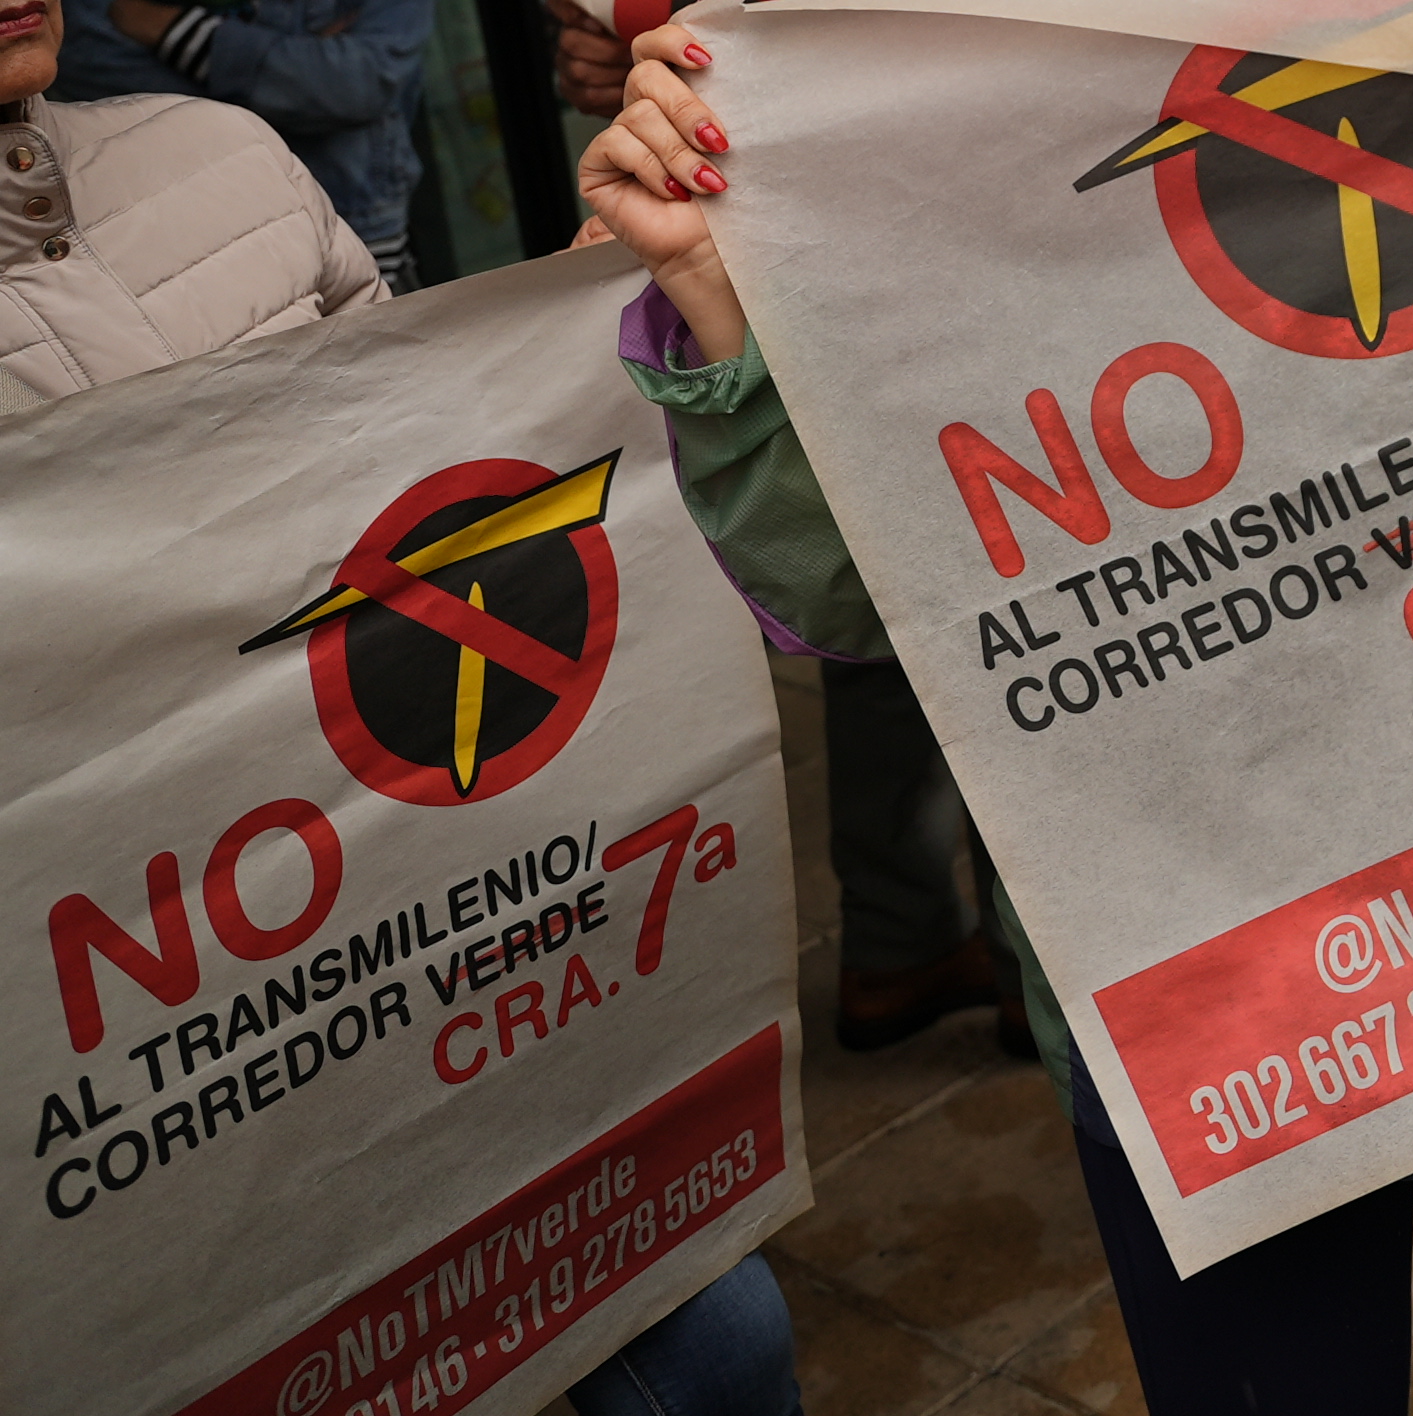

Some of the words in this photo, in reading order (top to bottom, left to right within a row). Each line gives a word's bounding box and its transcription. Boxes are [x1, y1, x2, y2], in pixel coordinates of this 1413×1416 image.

[938, 341, 1244, 579] NO
[979, 598, 1061, 670] AL
[1005, 542, 1368, 733] CORREDOR
[34, 1075, 123, 1157] AL
[129, 820, 598, 1093] TRANSMILENIO/
[48, 797, 344, 1054] NO
[432, 953, 622, 1084] CRA.
[45, 981, 412, 1219] CORREDOR
[425, 880, 610, 1006] VERDE
[1189, 1054, 1310, 1156] 302
[1297, 1001, 1406, 1106] 667
[276, 1153, 637, 1416] @NoTM7verde
[494, 1257, 575, 1353] 319
[583, 1209, 658, 1295] 278
[664, 1128, 758, 1234] 5653
